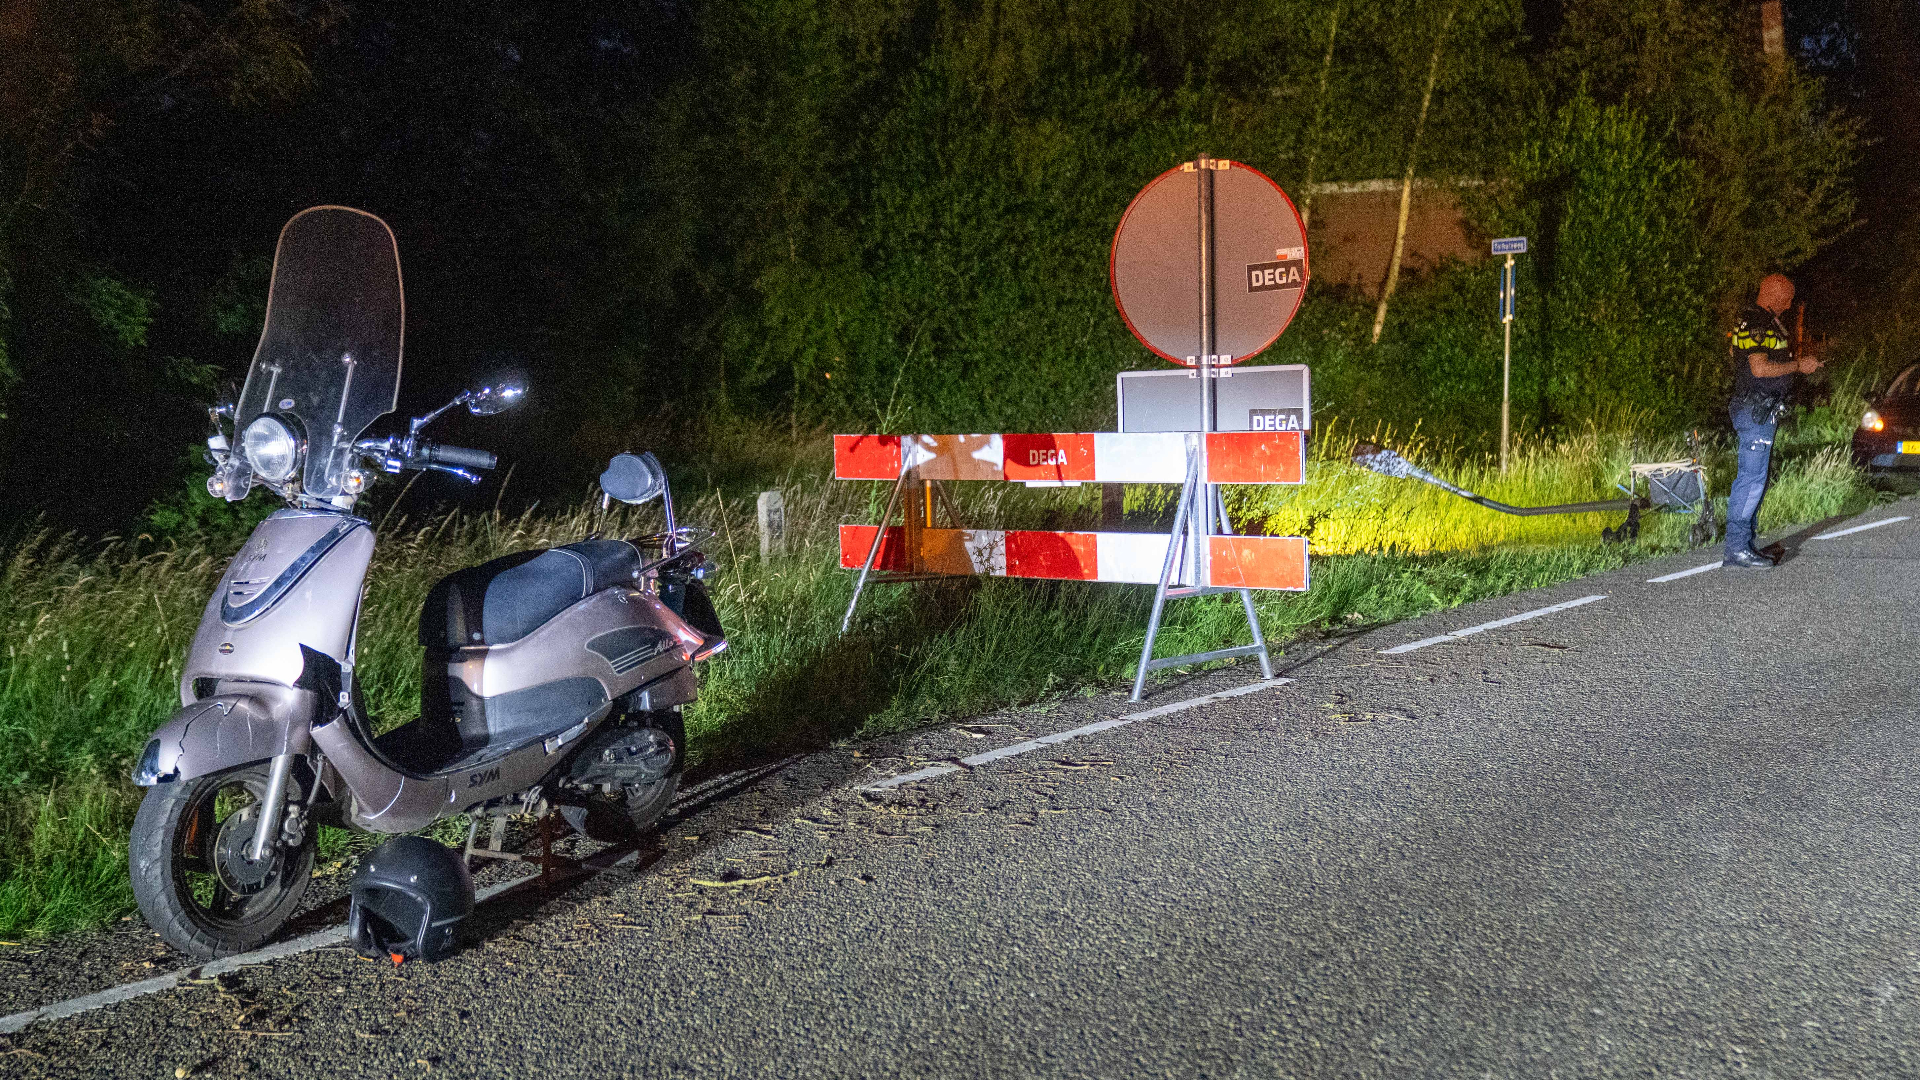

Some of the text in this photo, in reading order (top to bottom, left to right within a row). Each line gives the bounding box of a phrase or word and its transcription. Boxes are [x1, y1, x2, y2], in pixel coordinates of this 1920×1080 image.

[1251, 267, 1300, 286] DEGA
[1252, 414, 1300, 430] DEGA
[1029, 449, 1068, 466] DEGA
[468, 767, 500, 788] SYM
